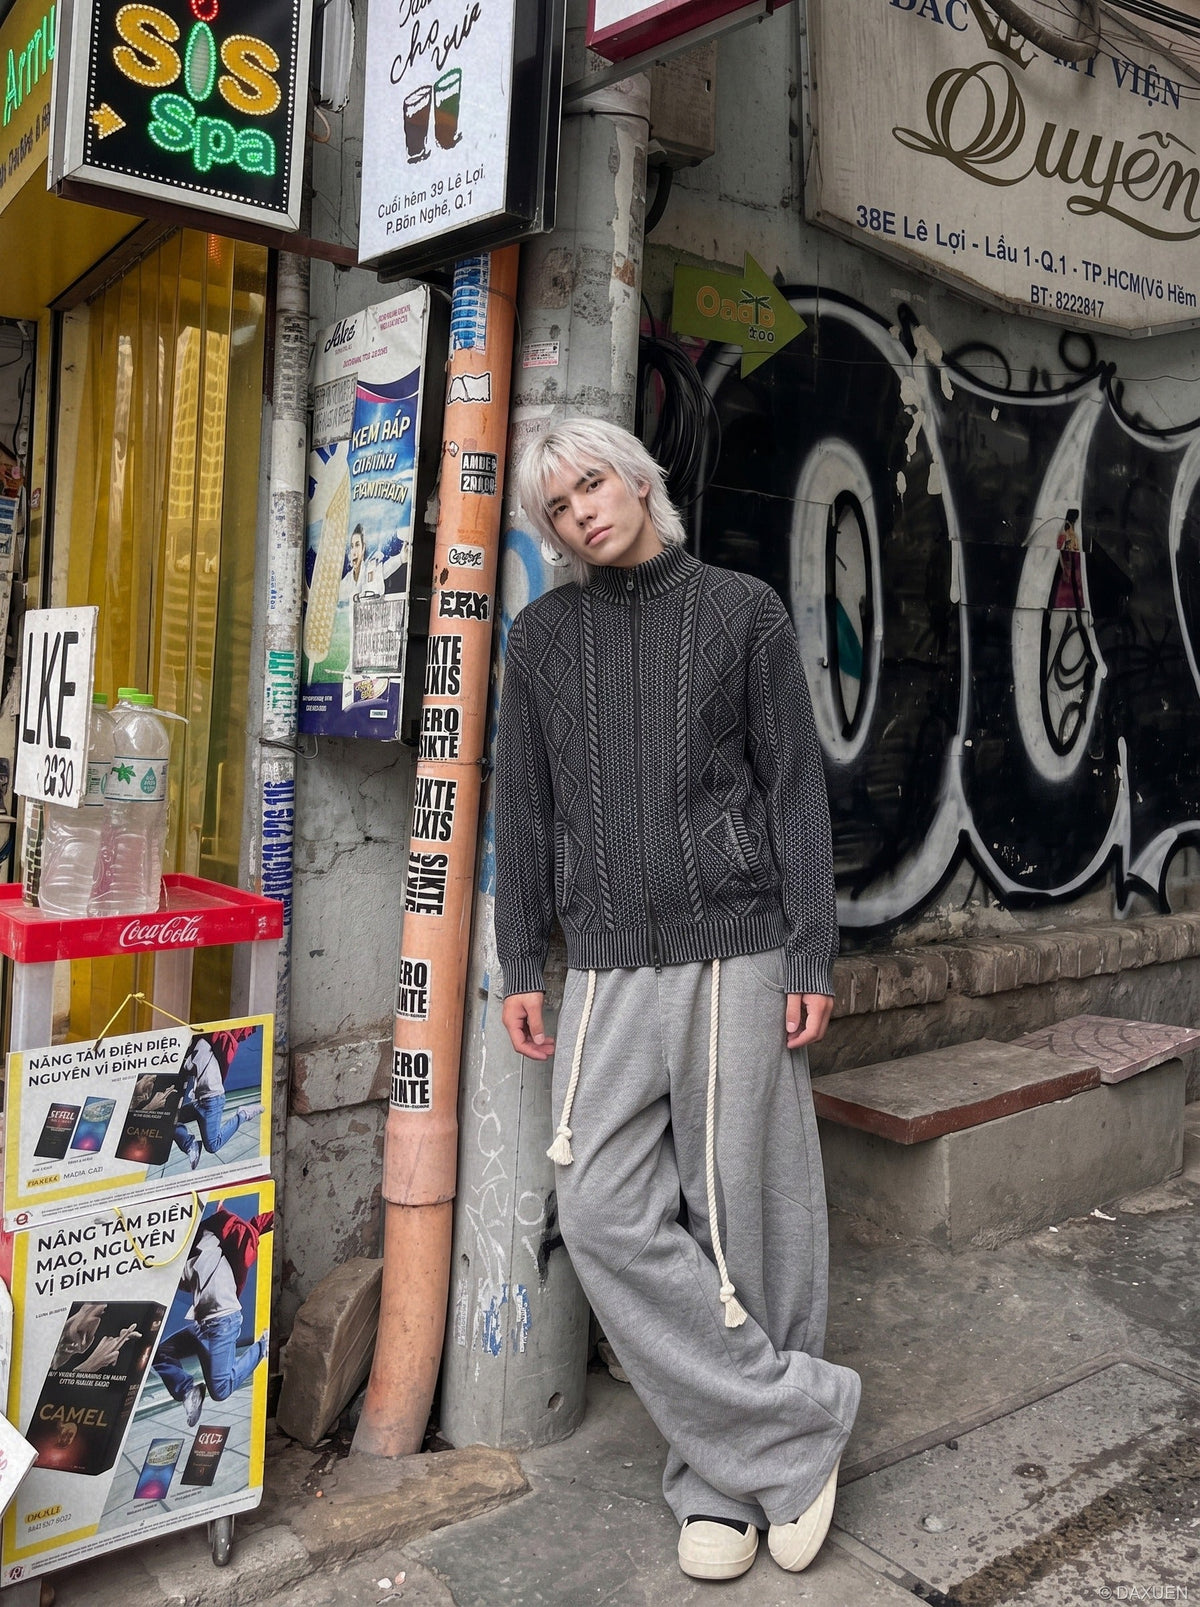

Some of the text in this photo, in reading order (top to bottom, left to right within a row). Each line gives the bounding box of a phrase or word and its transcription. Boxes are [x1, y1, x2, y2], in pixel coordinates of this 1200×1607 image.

[147, 93, 276, 176] Spa
[430, 180, 444, 198] 39
[448, 173, 462, 191] Lê
[454, 189, 473, 210] Q.1
[856, 204, 896, 235] 38E
[904, 215, 928, 242] Lê
[936, 223, 965, 254] Lợi
[352, 422, 381, 452] KEM
[22, 631, 79, 749] LKE
[119, 914, 203, 948] Coca-Cola
[28, 1066, 90, 1087] NGUYÊN
[127, 1127, 163, 1139] CAMEL
[36, 1228, 175, 1275] MAO, NGUYÊN
[60, 1264, 110, 1290] ĐÍNH
[40, 1403, 108, 1427] CAMEL
